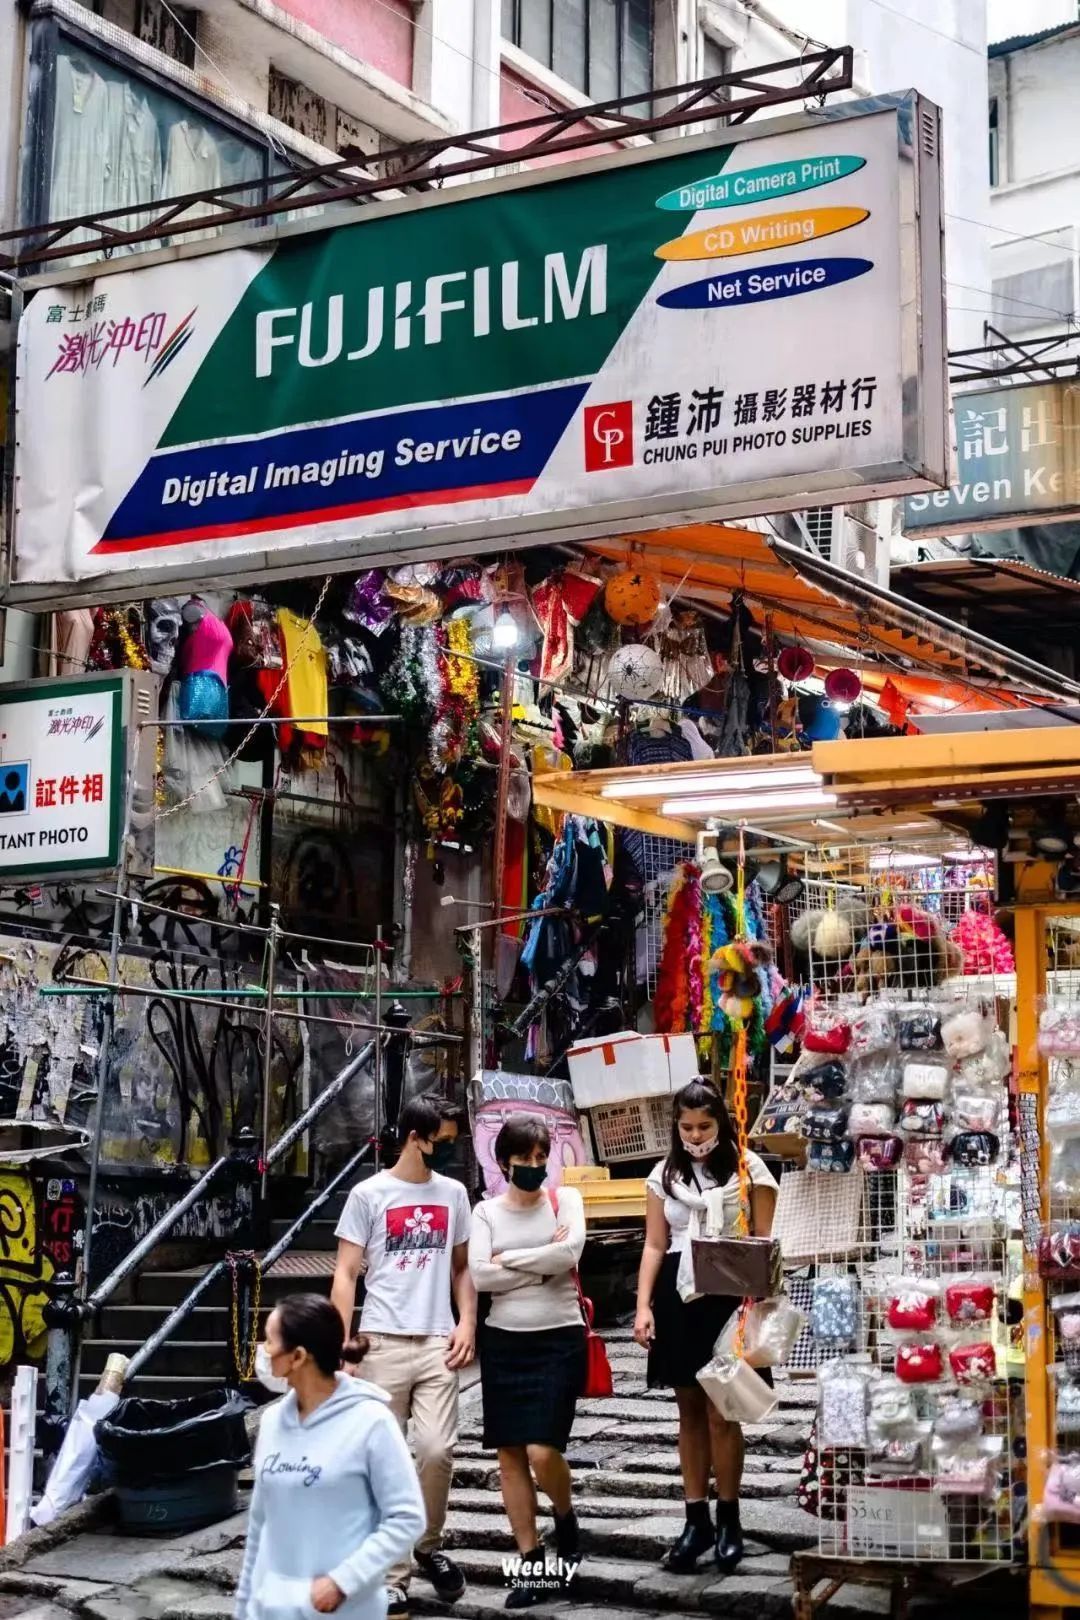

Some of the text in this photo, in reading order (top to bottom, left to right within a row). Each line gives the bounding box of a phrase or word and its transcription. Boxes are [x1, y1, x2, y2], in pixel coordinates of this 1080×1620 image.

[680, 158, 841, 208] Digital Camera Print
[704, 218, 814, 253] CD Writing
[708, 267, 826, 301] Net Service
[256, 244, 608, 378] FUJIFILM
[734, 376, 877, 427] 攝影器材行
[643, 420, 872, 465] CHUNG PUI PHOTO SUPPLIES
[161, 428, 522, 507] Digital Imaging Service
[909, 477, 1012, 511] Seven
[35, 773, 103, 808] 証件相
[39, 826, 89, 846] PHOTO
